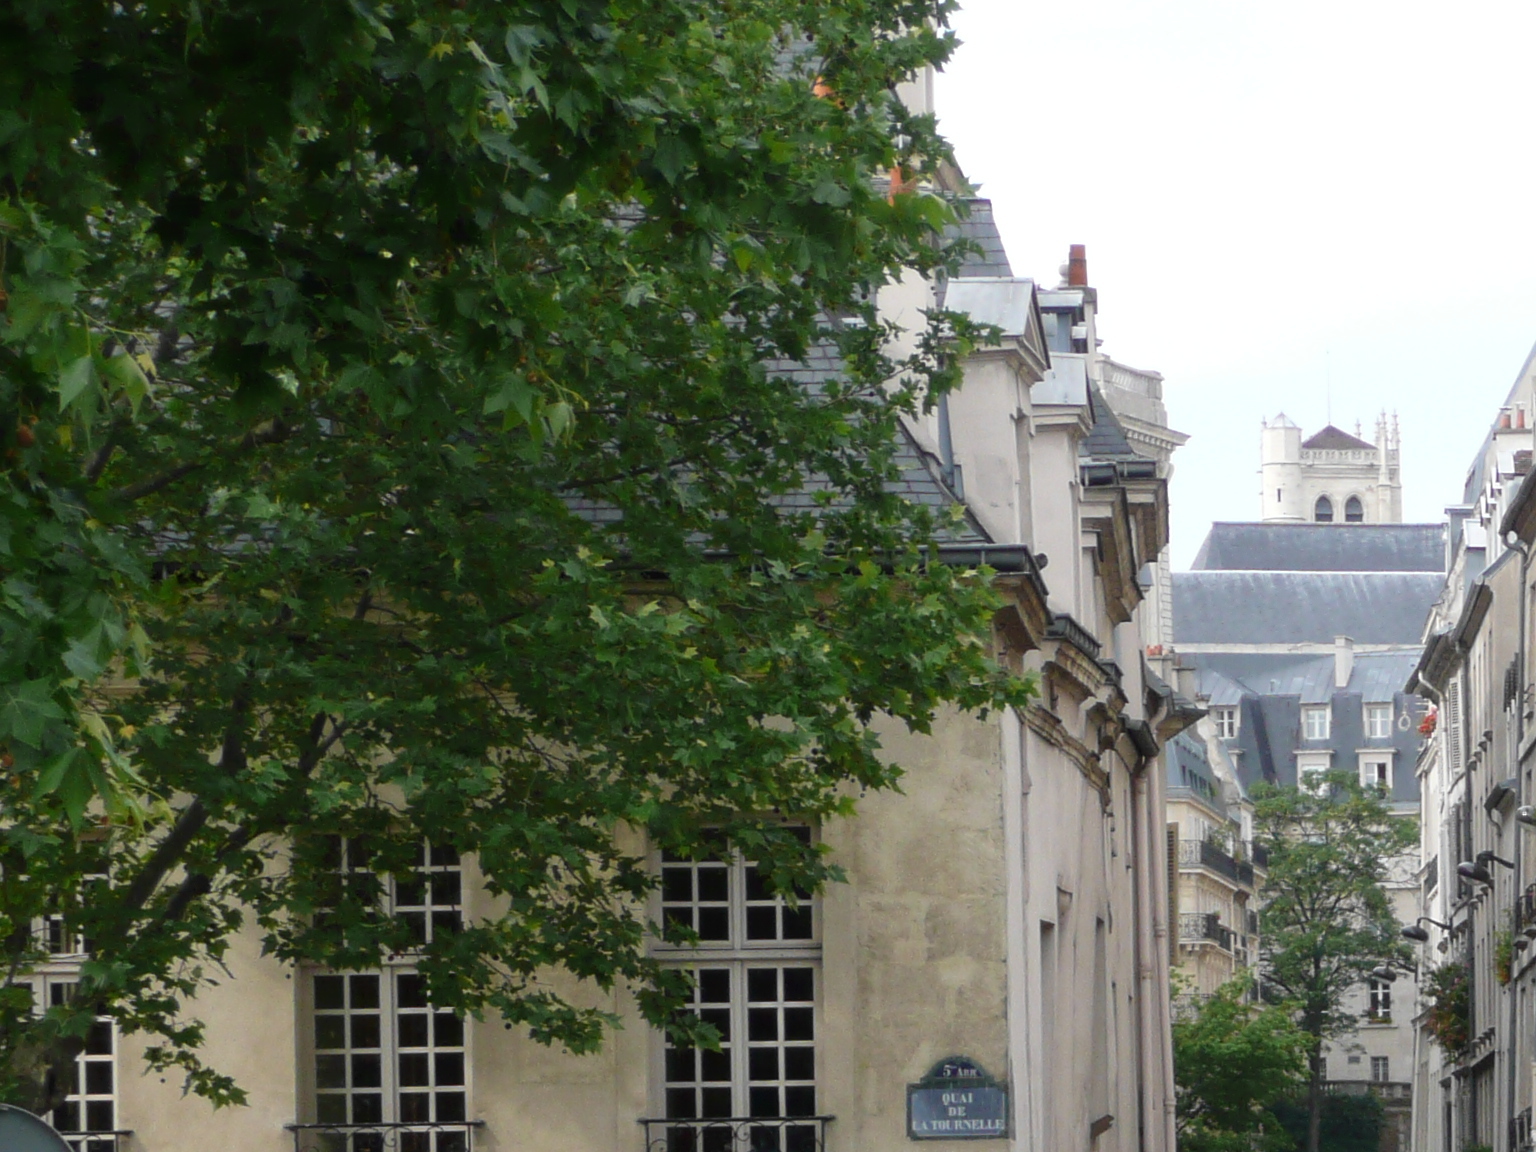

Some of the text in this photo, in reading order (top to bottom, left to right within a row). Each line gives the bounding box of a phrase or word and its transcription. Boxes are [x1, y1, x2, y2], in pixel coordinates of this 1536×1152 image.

[942, 1093, 973, 1105] QUAI
[948, 1106, 966, 1116] DE
[932, 1119, 1004, 1130] TOURNELLE
